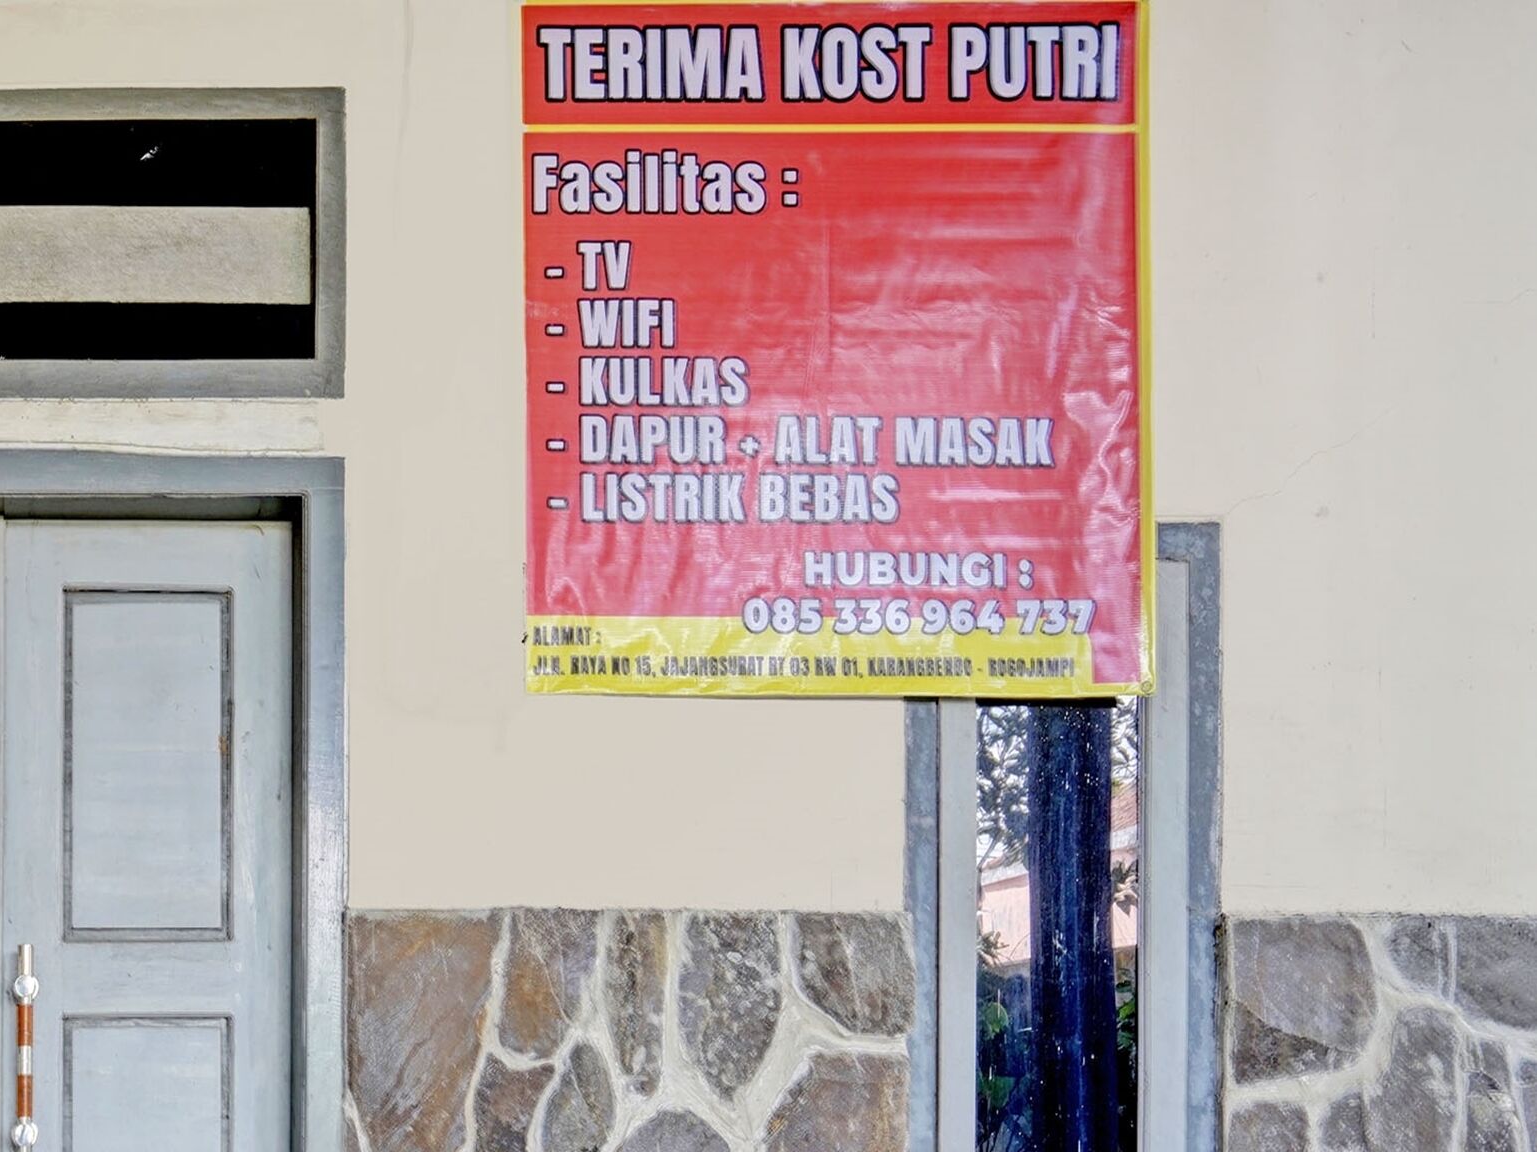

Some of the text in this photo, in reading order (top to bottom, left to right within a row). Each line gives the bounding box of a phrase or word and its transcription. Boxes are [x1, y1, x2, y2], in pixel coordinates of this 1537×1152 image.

[538, 23, 1120, 102] TERIMA KOST PUTRI
[531, 149, 767, 214] Fasilitas
[578, 240, 632, 290] TV
[578, 298, 675, 348] WIFI
[579, 355, 749, 407] KULKAS
[579, 415, 727, 465] DAPUR
[774, 415, 882, 466] ALAT
[895, 416, 1055, 468] MASAK
[580, 473, 746, 523] LISTRIK
[759, 473, 899, 523] BEBAS
[803, 550, 1007, 588] HUBUNGI
[533, 626, 591, 646] ALAMAT
[742, 597, 1096, 635] 085 336 964 737
[571, 656, 607, 675] RAYA
[612, 656, 631, 675] NO
